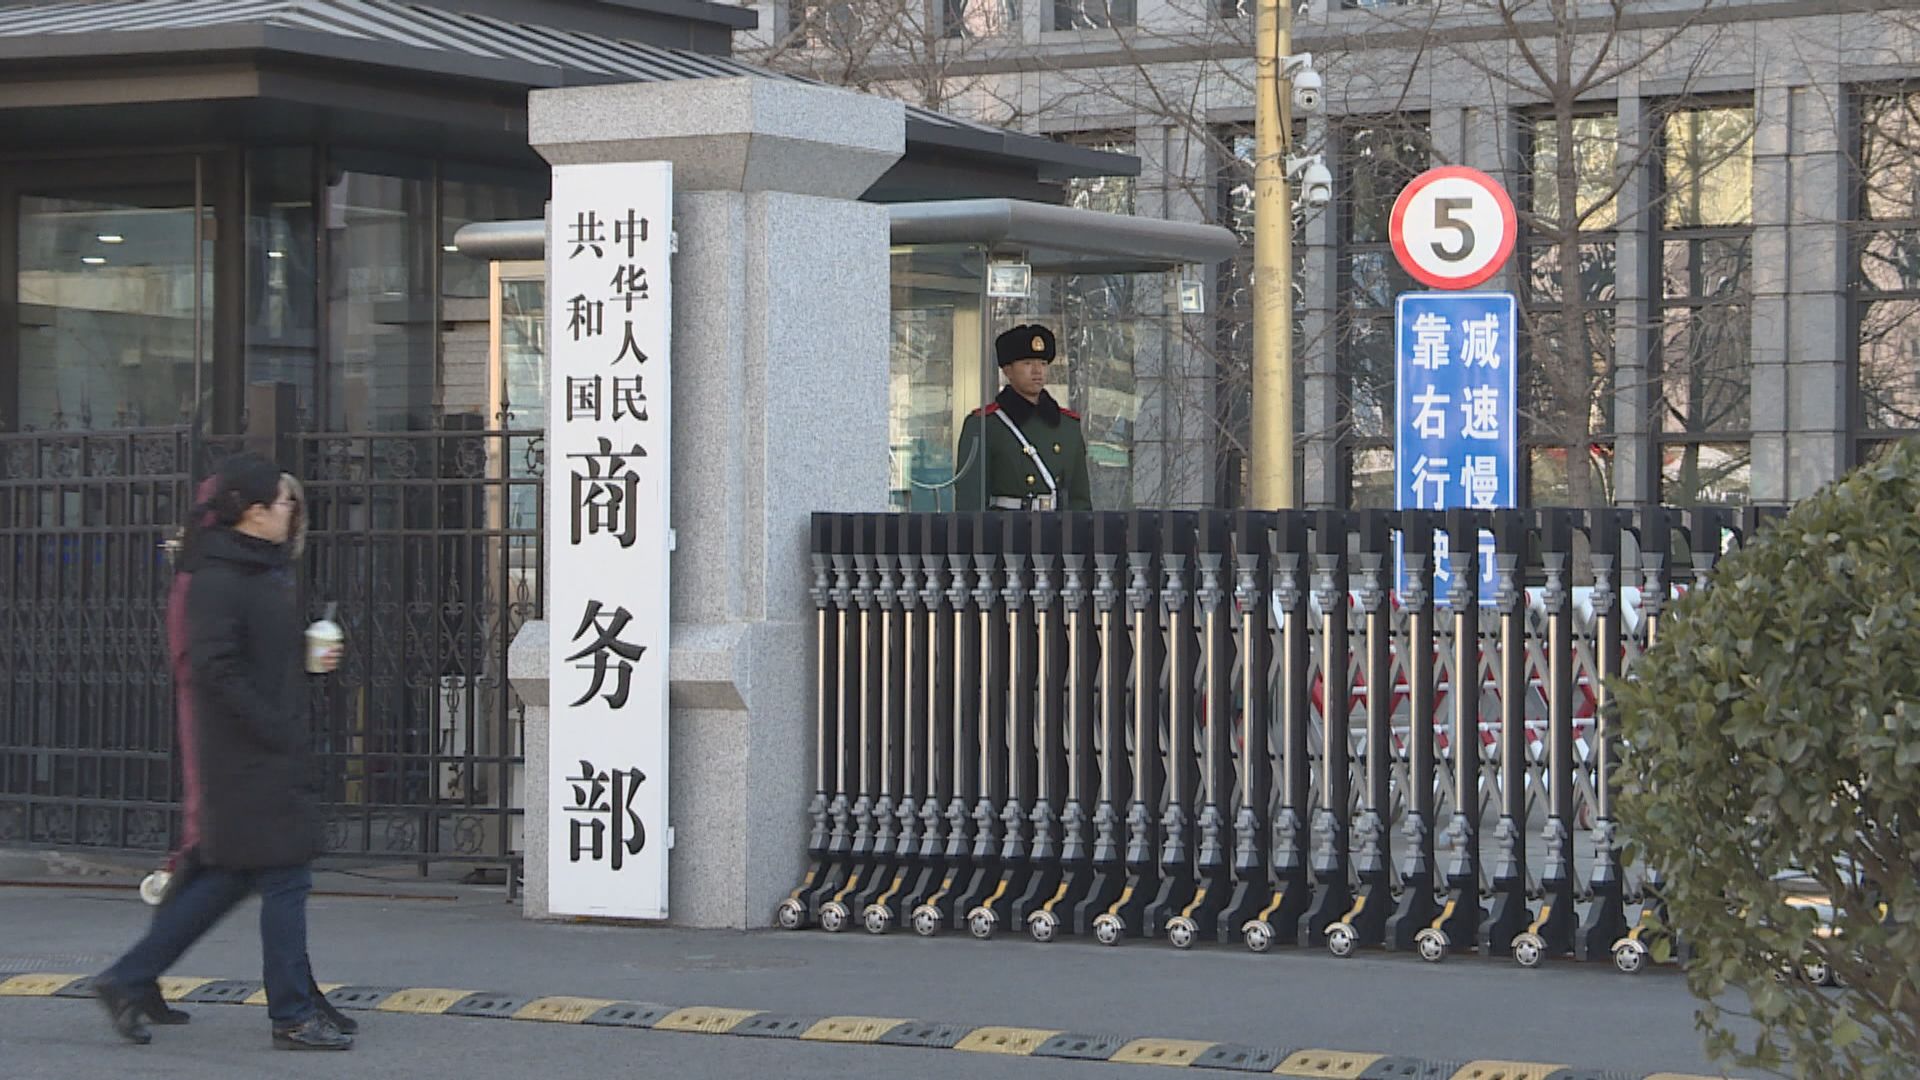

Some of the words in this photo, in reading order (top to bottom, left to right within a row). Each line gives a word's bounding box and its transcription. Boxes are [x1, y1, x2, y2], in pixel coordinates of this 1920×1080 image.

[566, 210, 606, 422] 共和国
[609, 208, 649, 422] 中华人民
[1431, 198, 1475, 261] 5
[563, 436, 648, 872] 商务部
